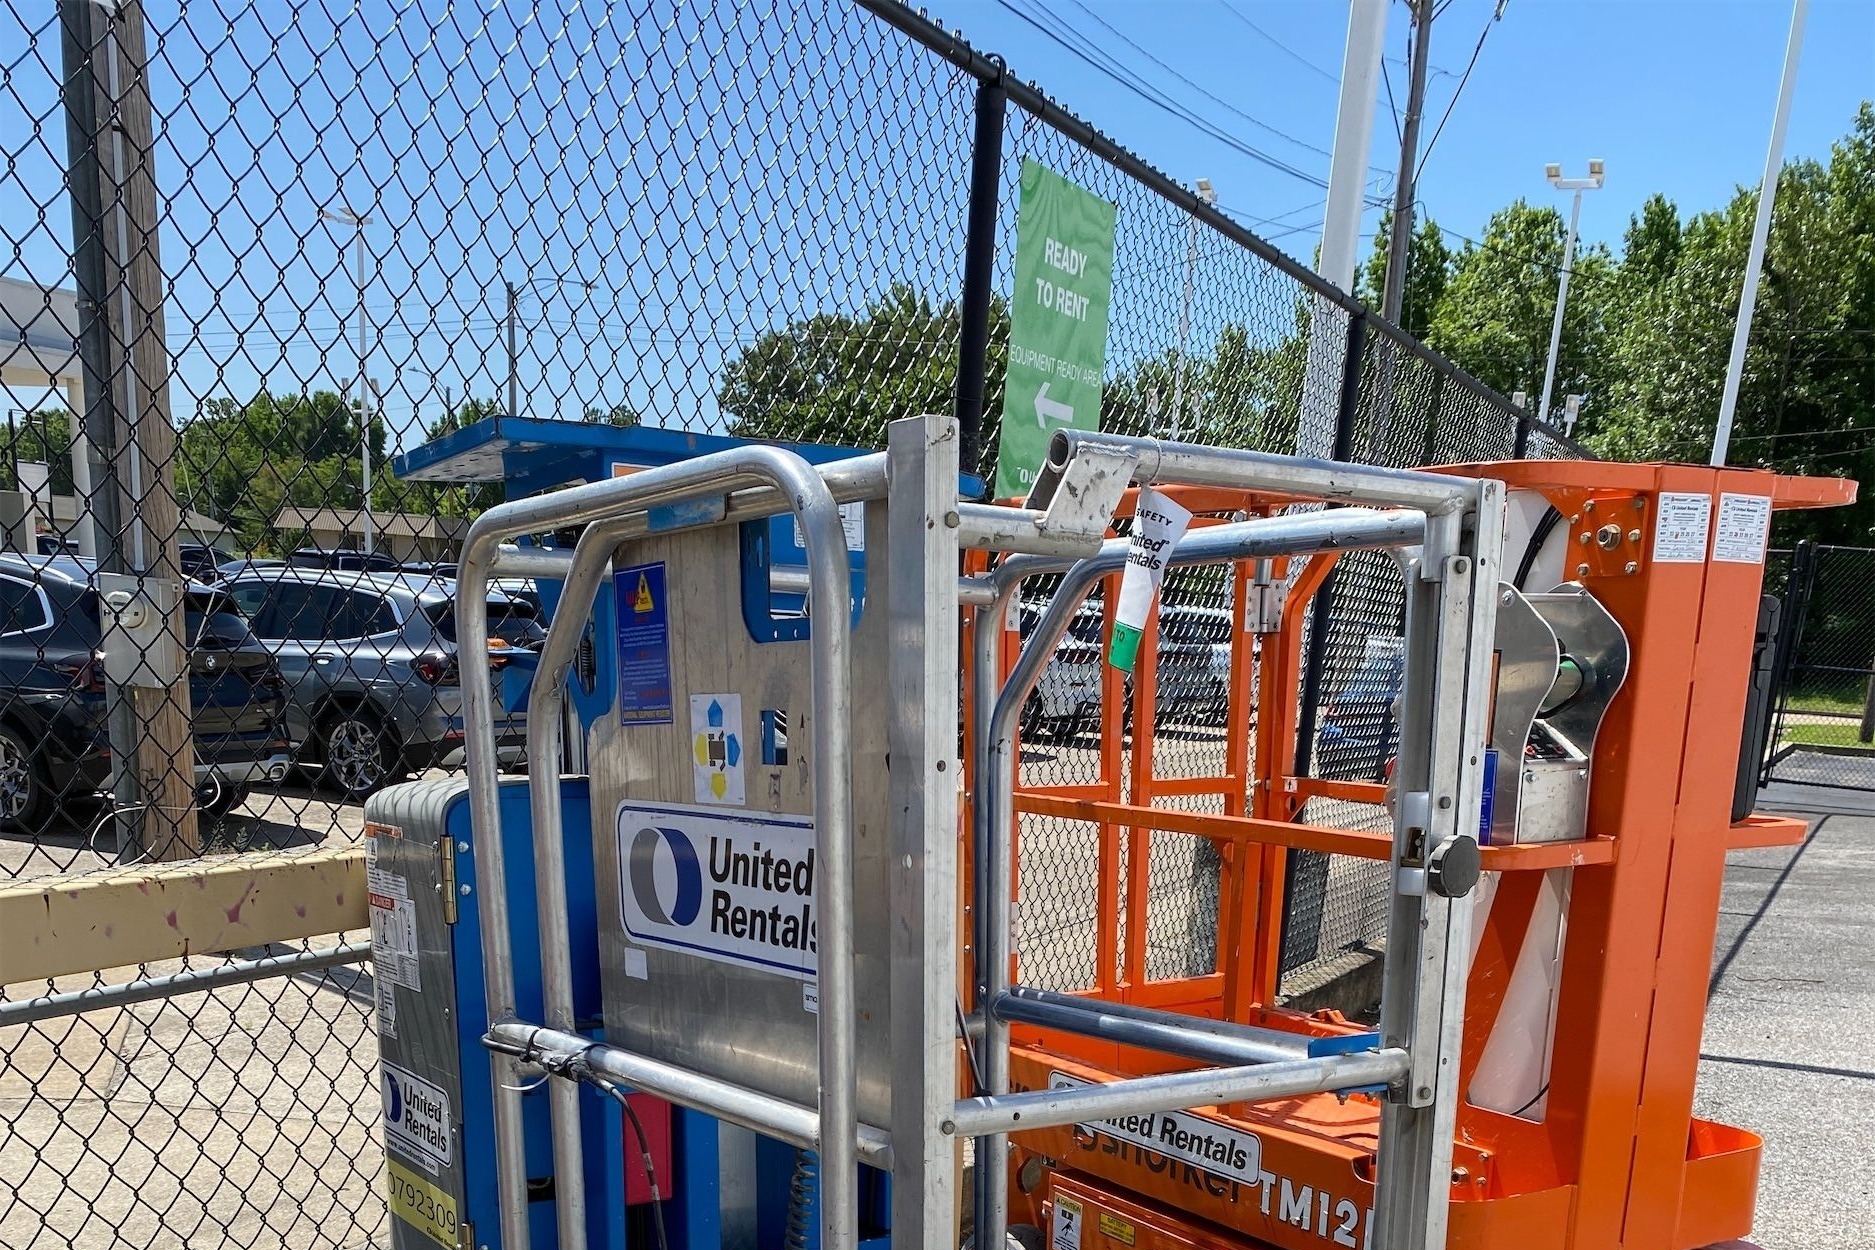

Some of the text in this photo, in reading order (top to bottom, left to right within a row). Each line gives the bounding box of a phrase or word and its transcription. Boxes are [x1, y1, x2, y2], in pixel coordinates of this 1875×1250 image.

[1044, 237, 1088, 279] READY
[1036, 278, 1090, 322] TO RENT
[1010, 343, 1057, 373] EQUIPMENT
[1056, 359, 1083, 381] READY
[1136, 508, 1173, 526] SAFETY
[1127, 552, 1162, 570] entals
[1131, 532, 1166, 552] nited
[708, 836, 815, 896] United
[403, 1081, 443, 1124] United
[404, 1108, 447, 1153] Rentals
[1159, 1116, 1248, 1170] Rentals
[388, 1171, 457, 1235] 0792309
[1061, 1198, 1081, 1213] CAUTION
